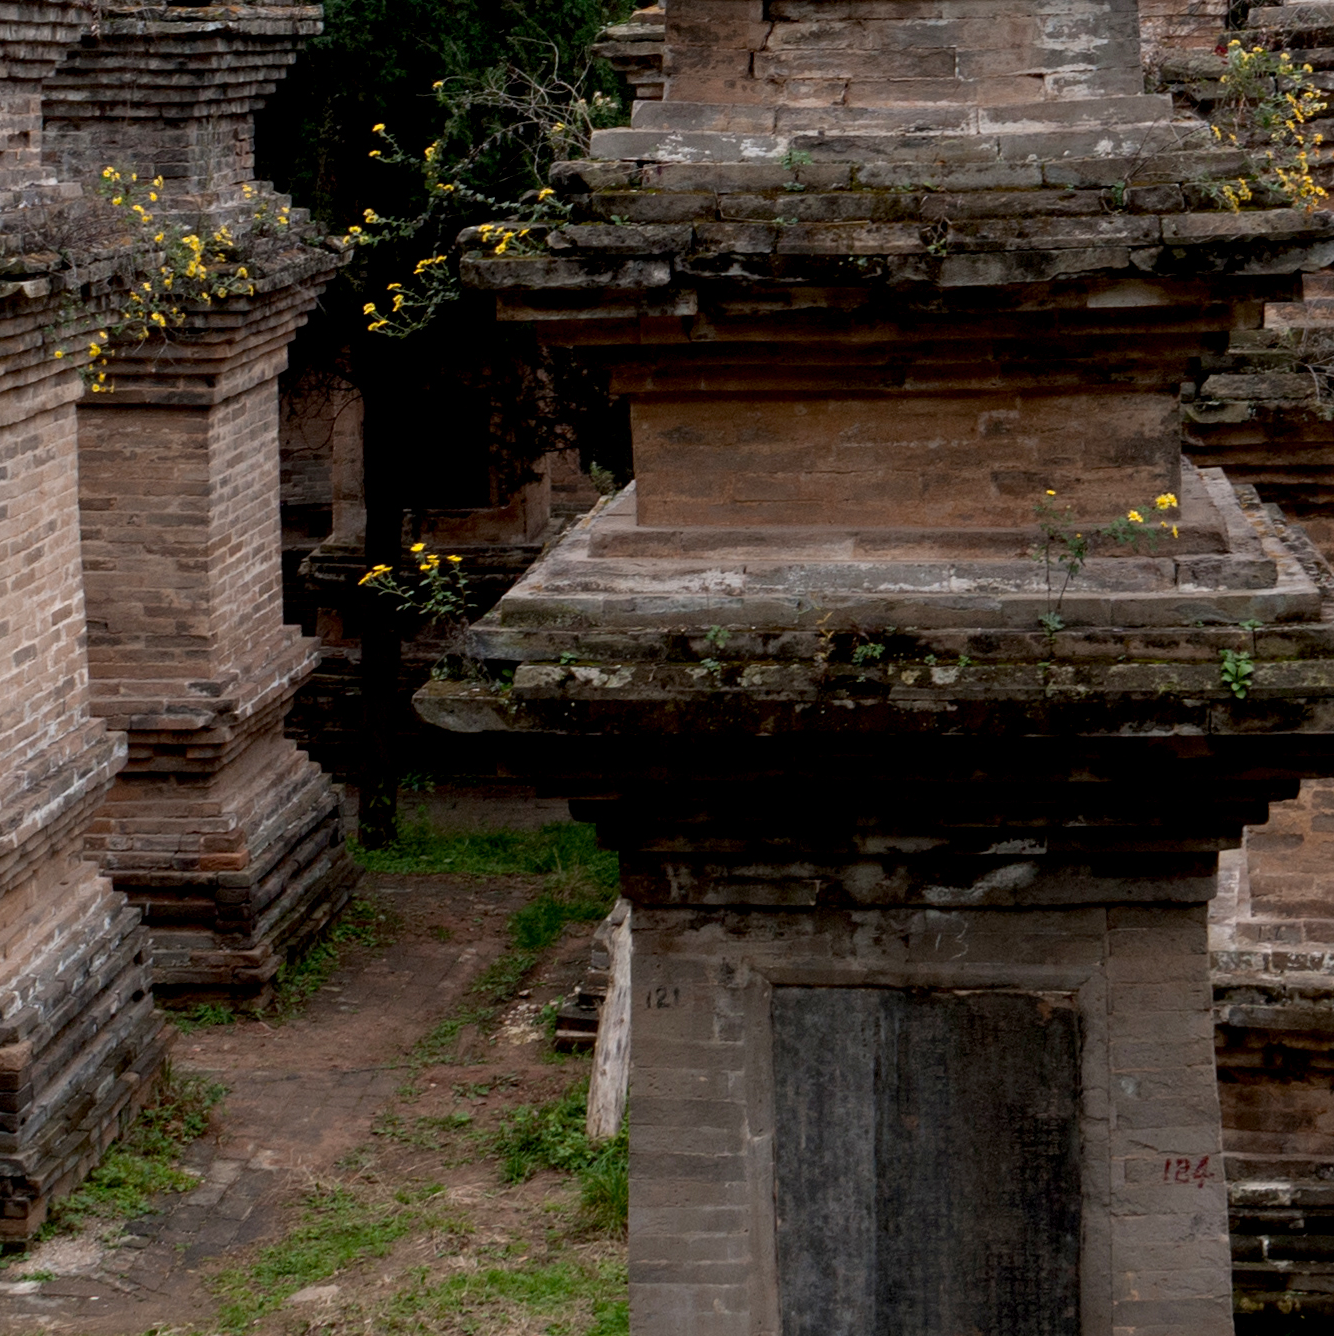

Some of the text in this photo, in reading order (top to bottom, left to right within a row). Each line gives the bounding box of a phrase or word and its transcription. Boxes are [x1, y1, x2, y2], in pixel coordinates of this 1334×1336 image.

[934, 919, 970, 961] 13
[646, 985, 680, 1010] 121
[1163, 1155, 1216, 1189] 124
